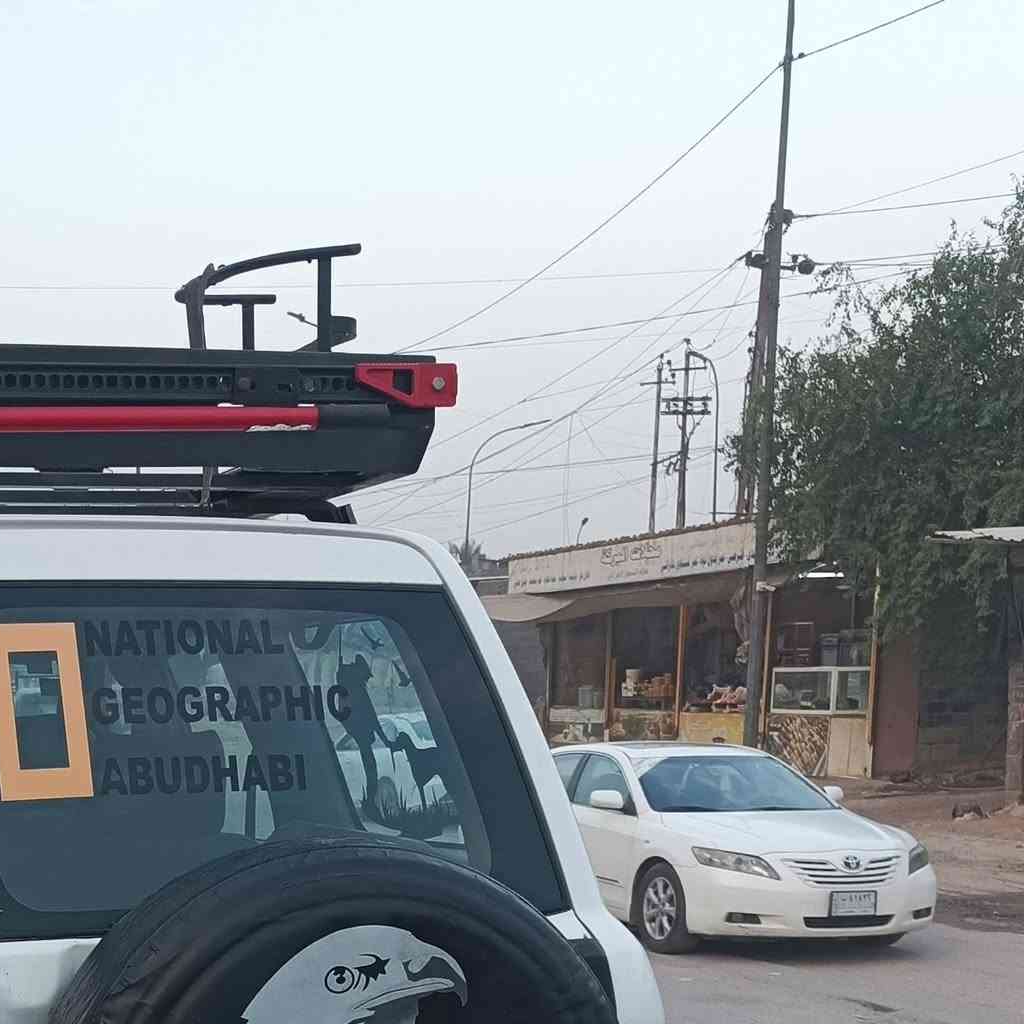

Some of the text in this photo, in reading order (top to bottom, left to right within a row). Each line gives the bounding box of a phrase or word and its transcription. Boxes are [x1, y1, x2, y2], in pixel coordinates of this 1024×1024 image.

[85, 619, 284, 657] NATIONAL
[92, 684, 352, 725] GEOGRAPHIC
[100, 753, 308, 796] ABUDHABI
